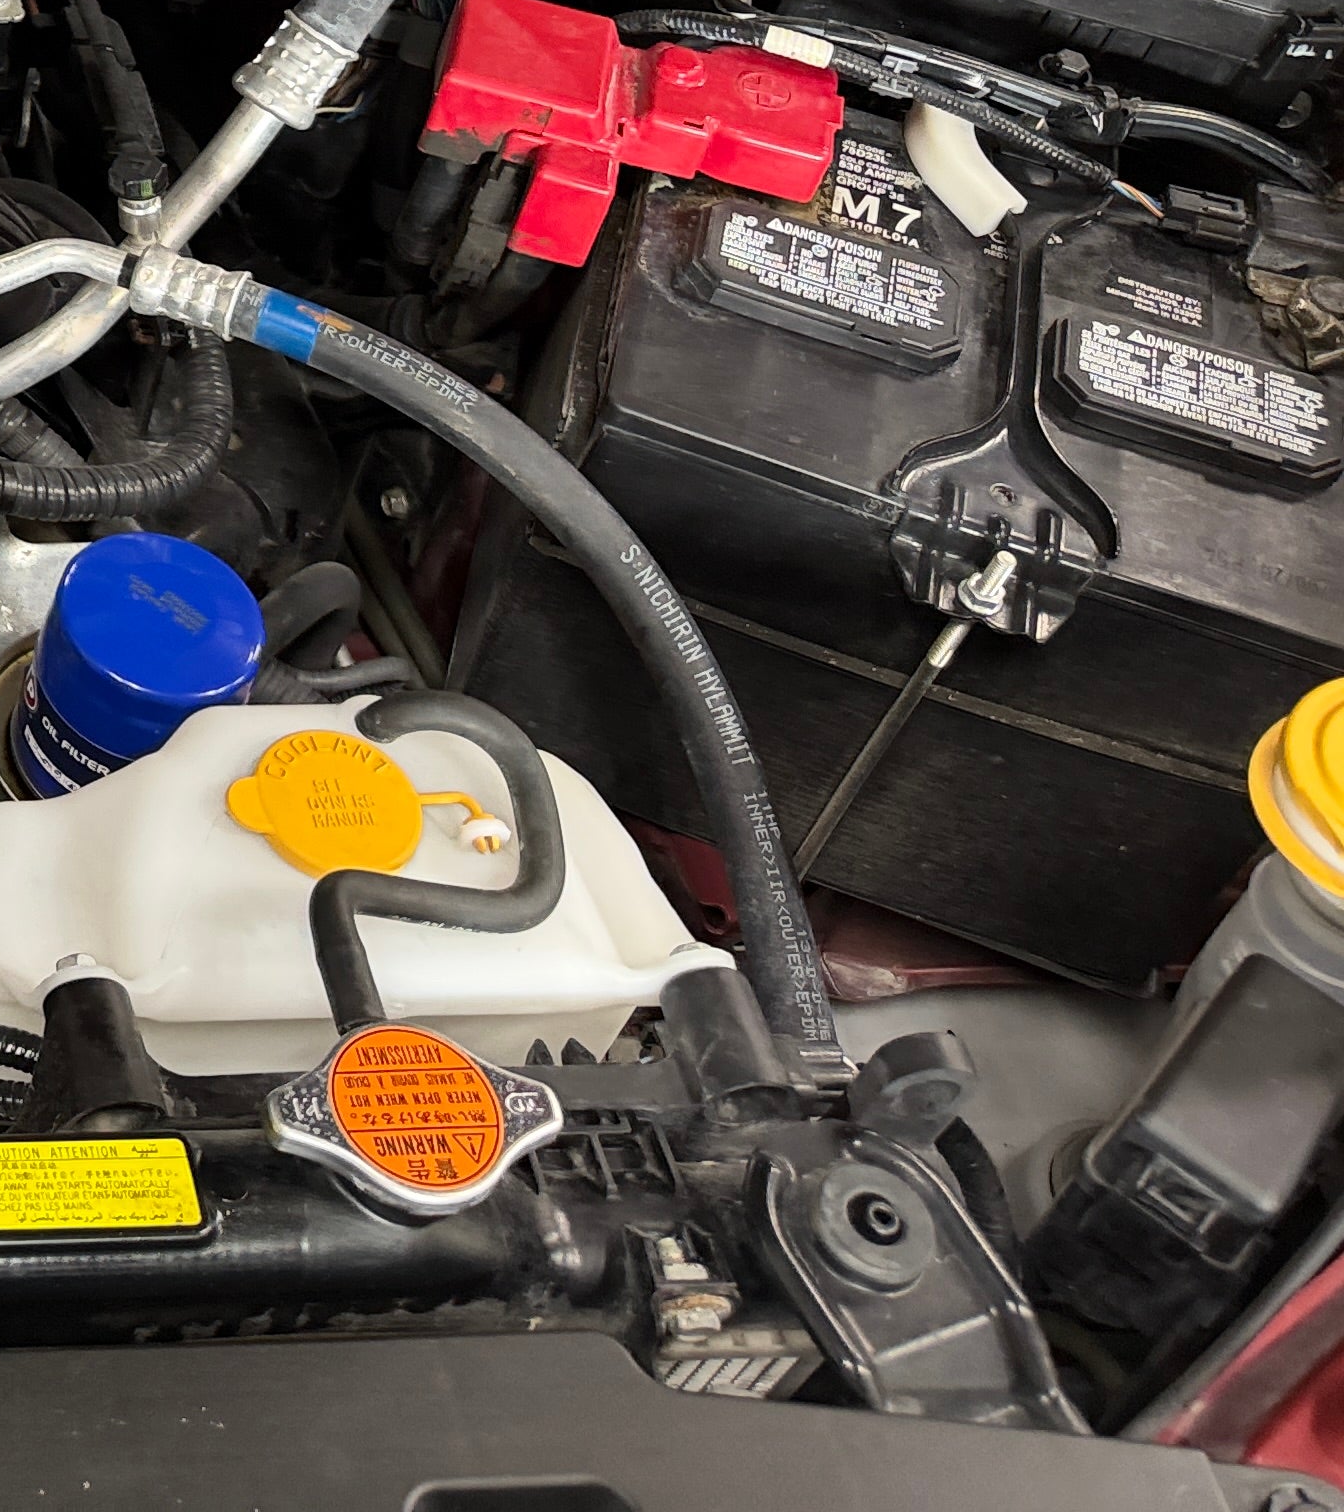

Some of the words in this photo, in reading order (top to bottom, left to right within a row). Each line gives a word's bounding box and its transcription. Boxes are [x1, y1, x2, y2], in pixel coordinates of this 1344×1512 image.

[836, 176, 886, 195] GROUP
[783, 222, 883, 262] DANGER/POISON
[1145, 334, 1255, 376] DANGER/POISON
[694, 667, 756, 765] HYLAMMIT
[42, 715, 60, 744] OIL
[61, 739, 110, 776] FILTER
[265, 736, 388, 778] COOLANT
[376, 1093, 408, 1106] WHEN
[412, 1092, 442, 1105] OPEN
[447, 1091, 482, 1104] NEVER
[51, 1146, 118, 1159] ATTENTION
[373, 1134, 453, 1157] WARNING
[408, 1158, 459, 1180] 警告
[36, 1182, 54, 1191] FAN
[59, 1181, 92, 1190] STARTS
[25, 1202, 42, 1211] PAS
